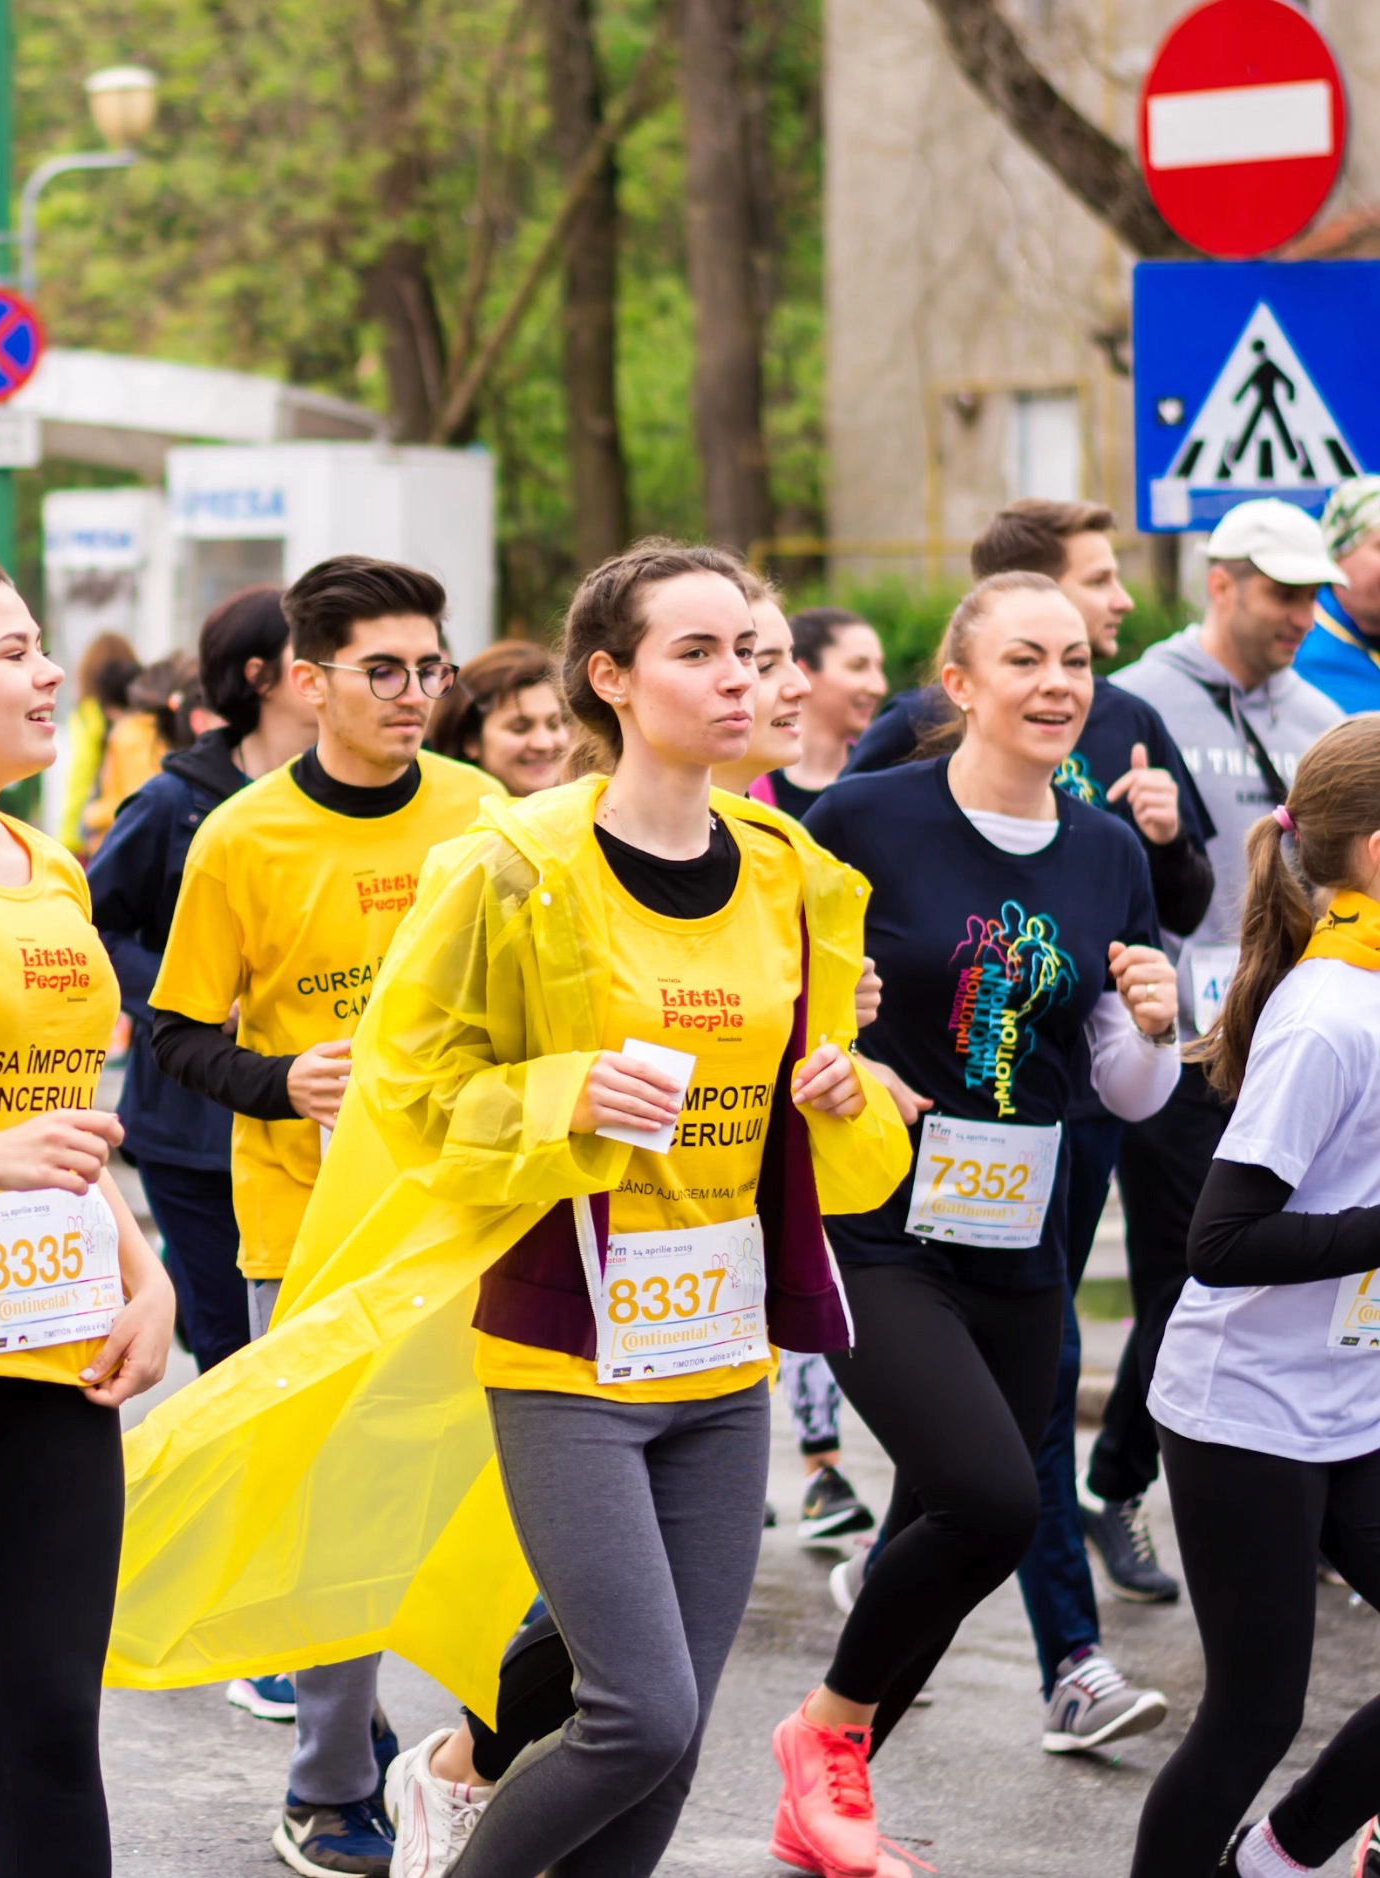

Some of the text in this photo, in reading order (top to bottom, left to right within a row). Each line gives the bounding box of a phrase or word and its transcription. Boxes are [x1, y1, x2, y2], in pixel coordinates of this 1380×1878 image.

[358, 891, 417, 915] Peopl
[20, 947, 87, 968] Little
[23, 969, 90, 993] People
[297, 964, 373, 995] CURSA
[659, 988, 741, 1007] Little
[948, 968, 971, 1031] TIMOTION
[955, 966, 984, 1054] TIMOTION
[662, 1009, 744, 1032] People
[964, 962, 1002, 1089] TIMOTION
[982, 977, 1013, 1080] TIMOTION
[26, 1043, 106, 1074] ÎMPOTR
[993, 1008, 1018, 1118] TIMOTION
[682, 1081, 774, 1112] MPOTRI
[929, 1154, 1030, 1201] 7352
[711, 1188, 735, 1199] MAI
[11, 1207, 33, 1218] aprilie
[632, 1248, 643, 1256] 14
[644, 1245, 671, 1256] aprilie
[673, 1244, 693, 1253] 2019
[90, 1286, 102, 1307] 2
[607, 1267, 727, 1325] 8337
[743, 1312, 757, 1320] CROS
[621, 1316, 757, 1353] Continental 2 KM
[672, 1357, 705, 1369] TIMOTION
